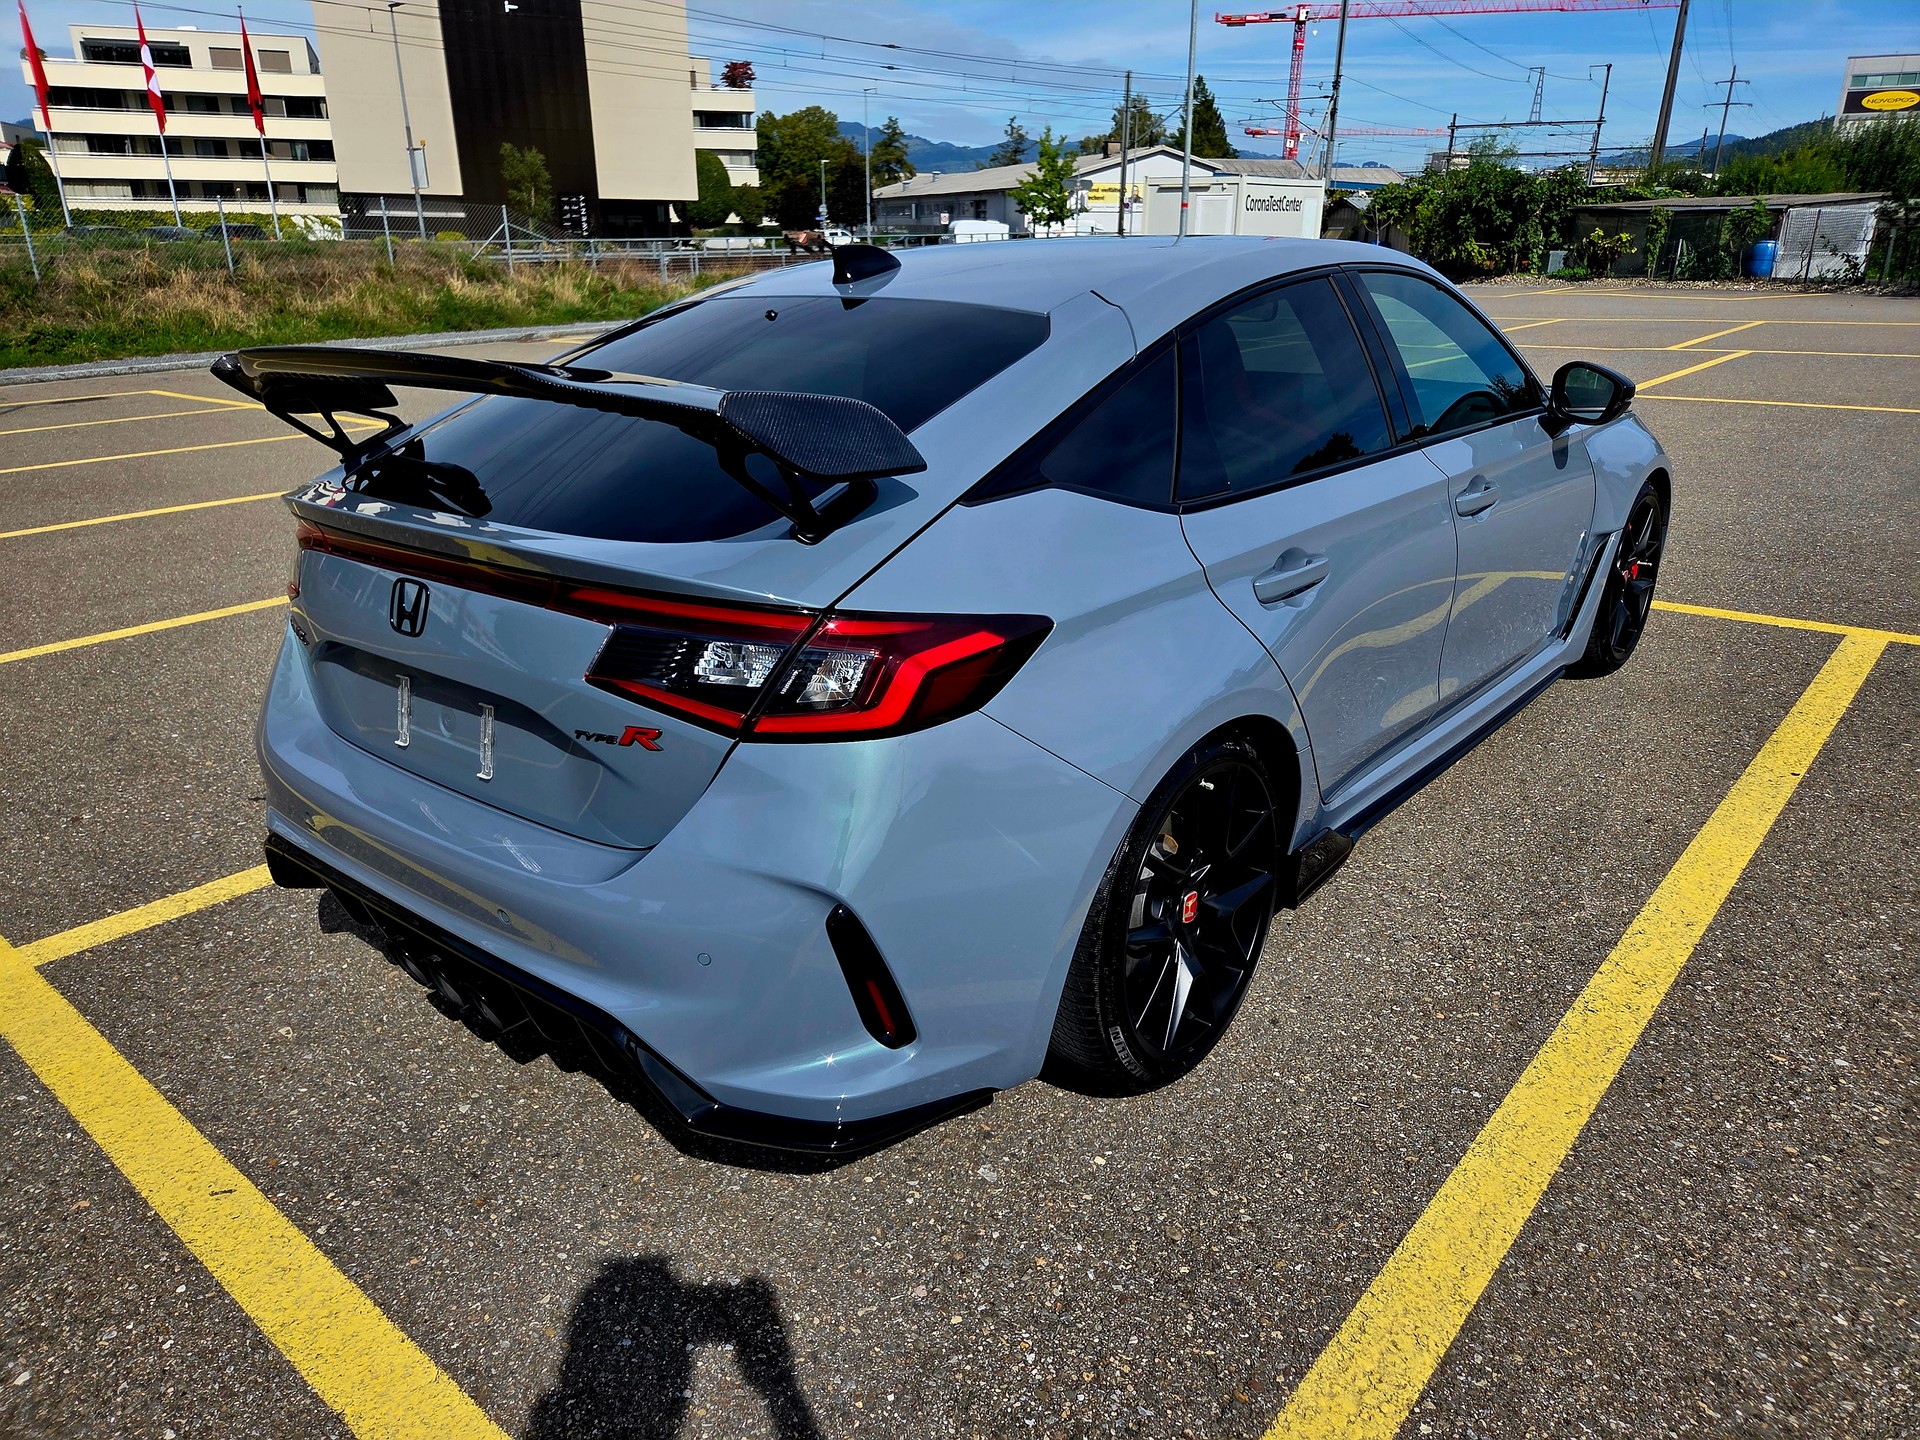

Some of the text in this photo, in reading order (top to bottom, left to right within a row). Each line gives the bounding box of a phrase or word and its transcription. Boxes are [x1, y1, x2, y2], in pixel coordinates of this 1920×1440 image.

[1866, 96, 1915, 104] NOVOPOS
[1245, 194, 1303, 212] CoronaTestCenter
[574, 725, 664, 751] TYPE R
